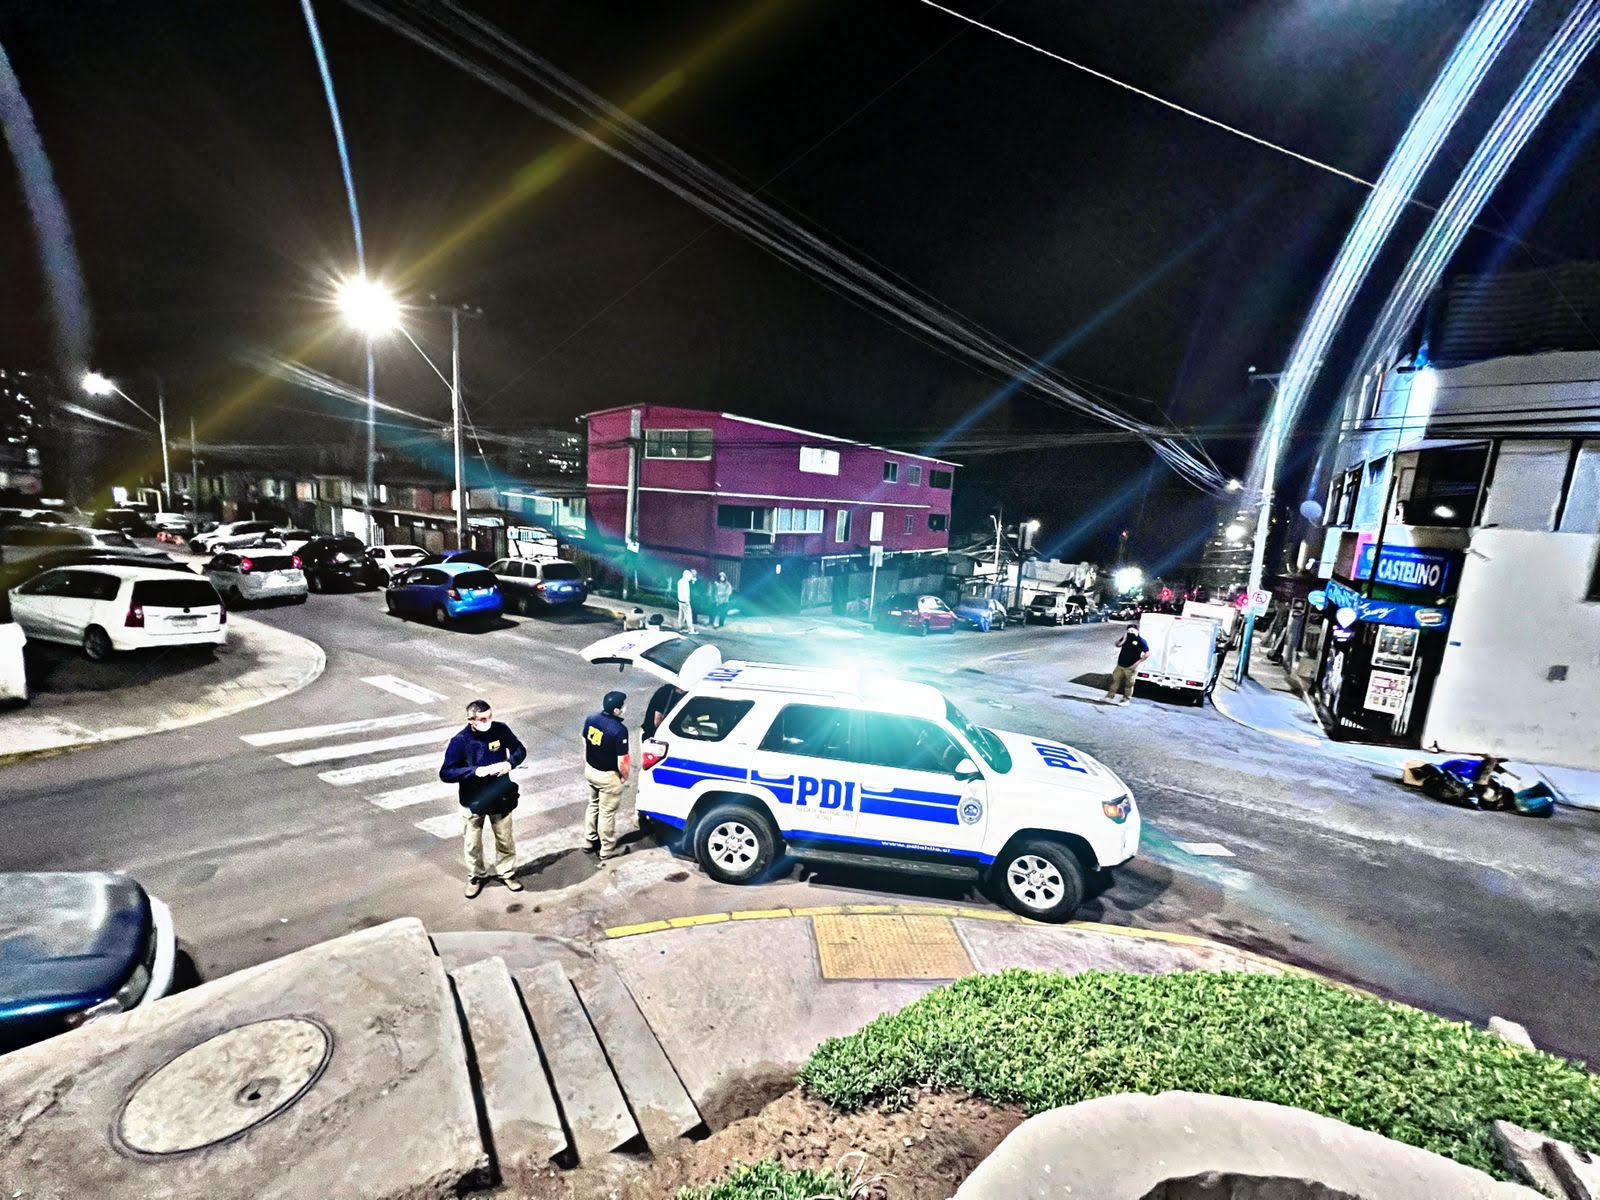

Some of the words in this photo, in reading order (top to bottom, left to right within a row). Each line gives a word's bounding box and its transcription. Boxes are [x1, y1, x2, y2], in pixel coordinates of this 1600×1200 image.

[1378, 559, 1440, 587] CASTELINO
[1031, 742, 1089, 775] PDI
[796, 775, 855, 812] PDI
